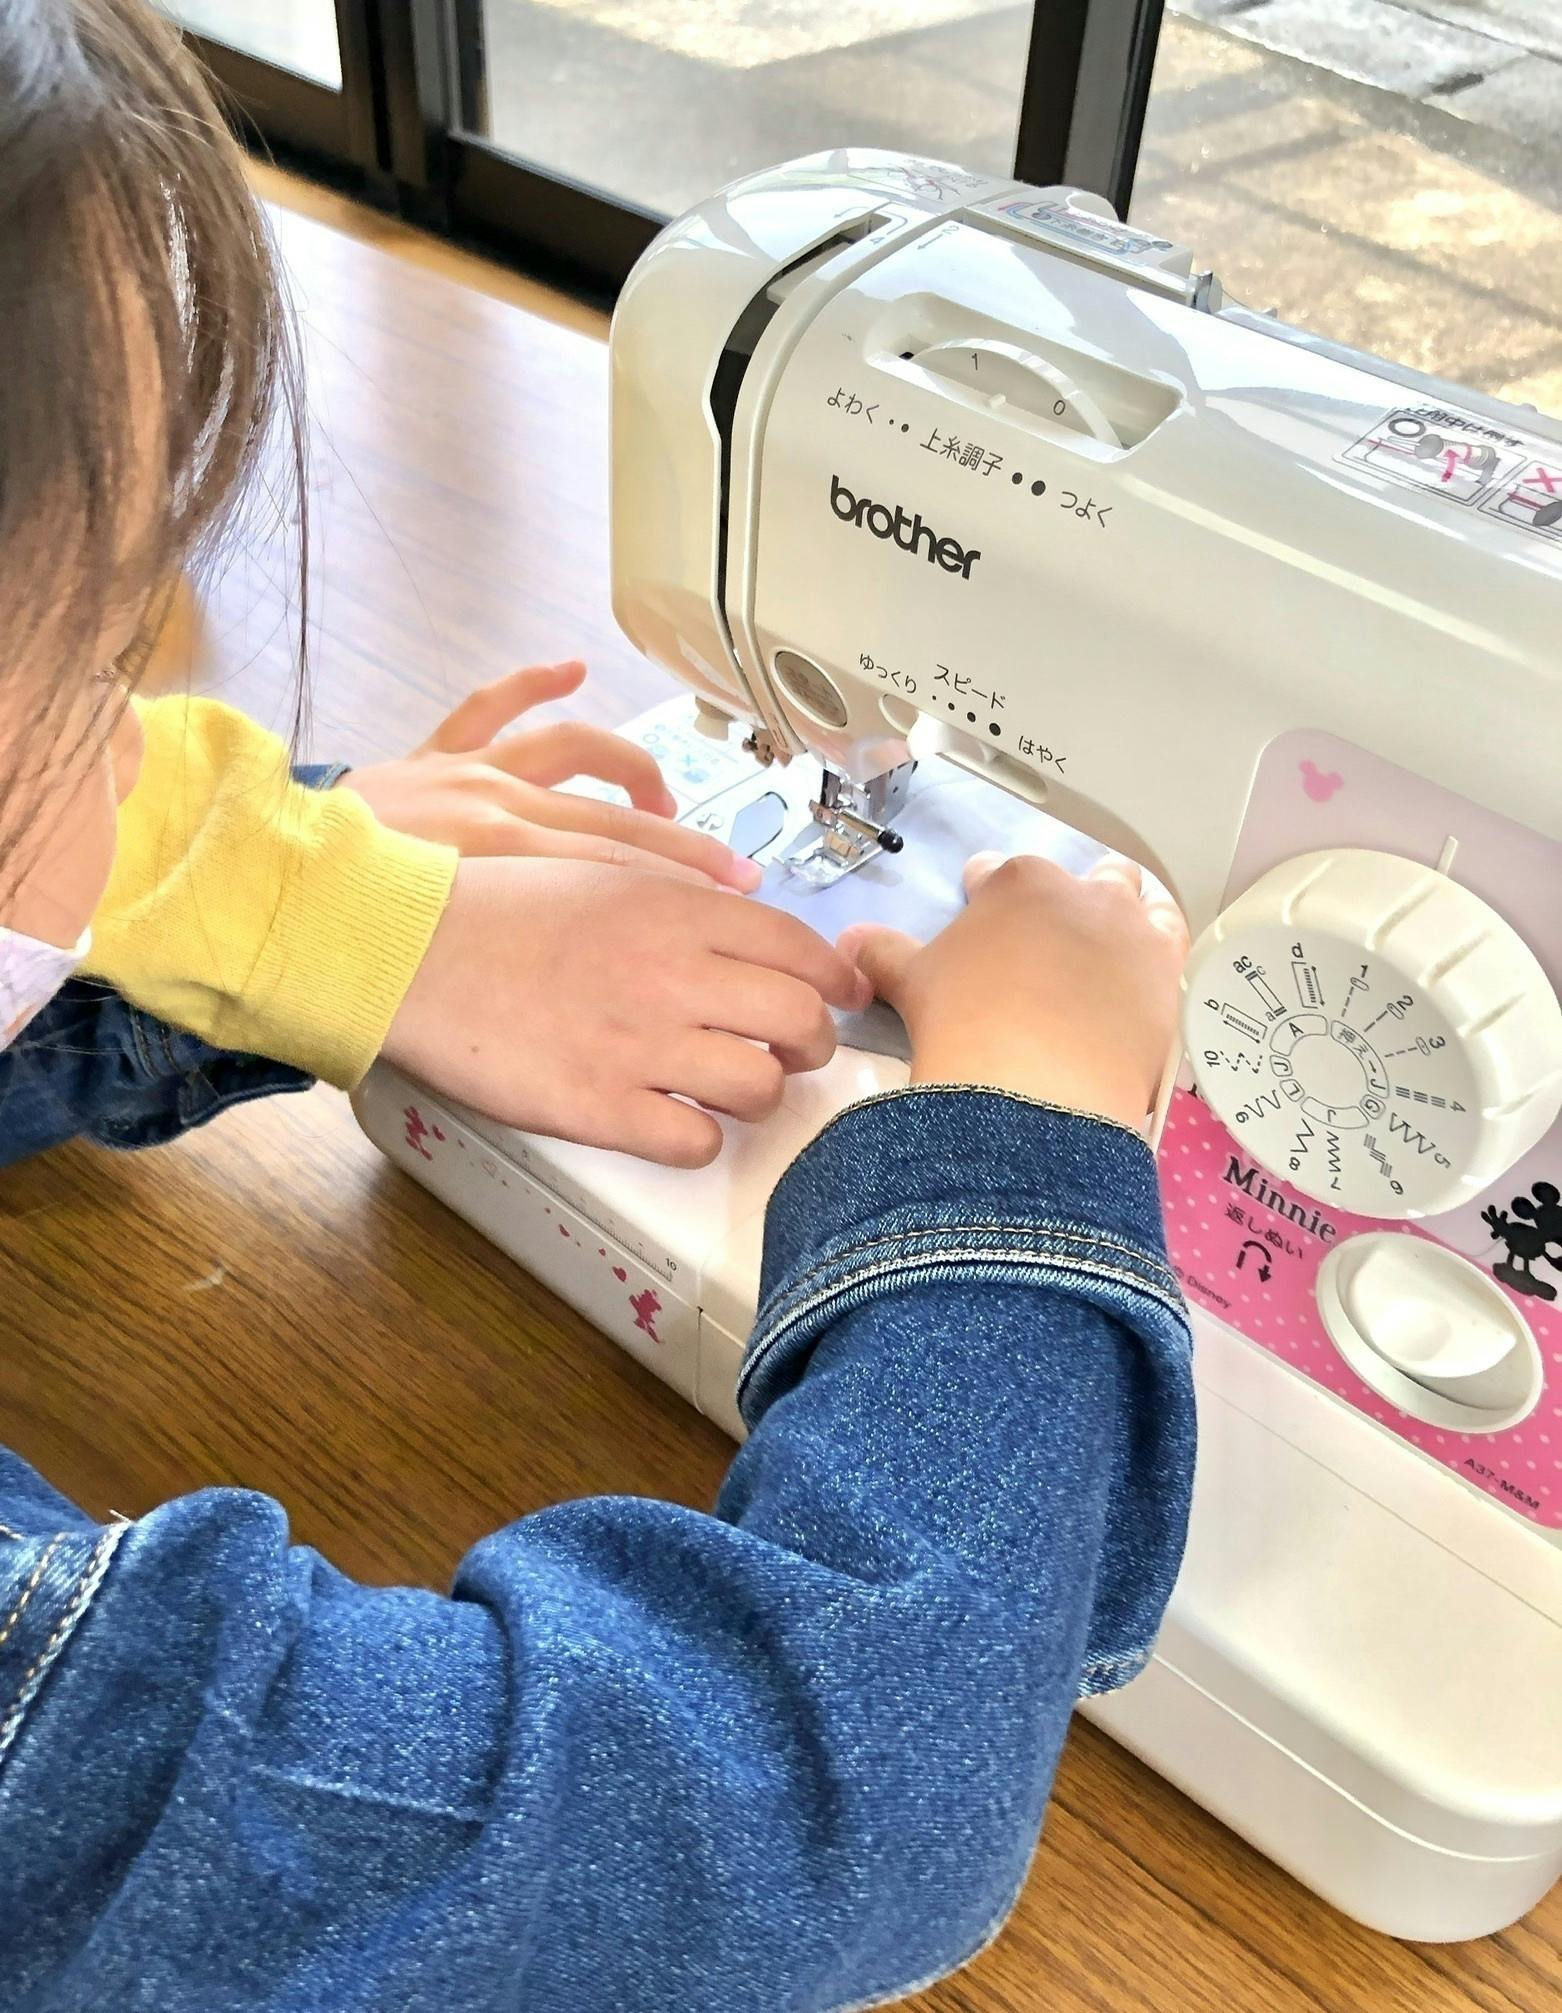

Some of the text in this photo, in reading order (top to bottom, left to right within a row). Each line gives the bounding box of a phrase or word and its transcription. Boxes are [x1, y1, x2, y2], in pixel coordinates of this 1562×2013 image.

[971, 353, 979, 371] 1
[1053, 400, 1066, 416] 0
[826, 387, 1113, 528] よわく 上糸調子 つよく
[829, 474, 981, 580] brother
[934, 663, 1006, 709] スピード
[859, 653, 1067, 774] ゆっくり はやく
[1291, 942, 1304, 959] d
[1232, 955, 1253, 973] ac
[1360, 964, 1368, 978] 1
[1203, 998, 1220, 1011] b
[1396, 995, 1414, 1011] 2
[1289, 1022, 1304, 1038] A
[1428, 1036, 1446, 1049] 3
[1203, 1050, 1220, 1068] 10
[1364, 1099, 1380, 1113] G
[1449, 1101, 1466, 1113] 4
[1289, 1156, 1301, 1171] 8
[1433, 1152, 1451, 1169] 5
[1330, 1176, 1341, 1190] 7
[1223, 1156, 1337, 1245] Minnie
[1224, 1202, 1304, 1259] 返しぬい
[664, 1257, 678, 1272] 10
[1463, 1458, 1541, 1509] A37-M&M
